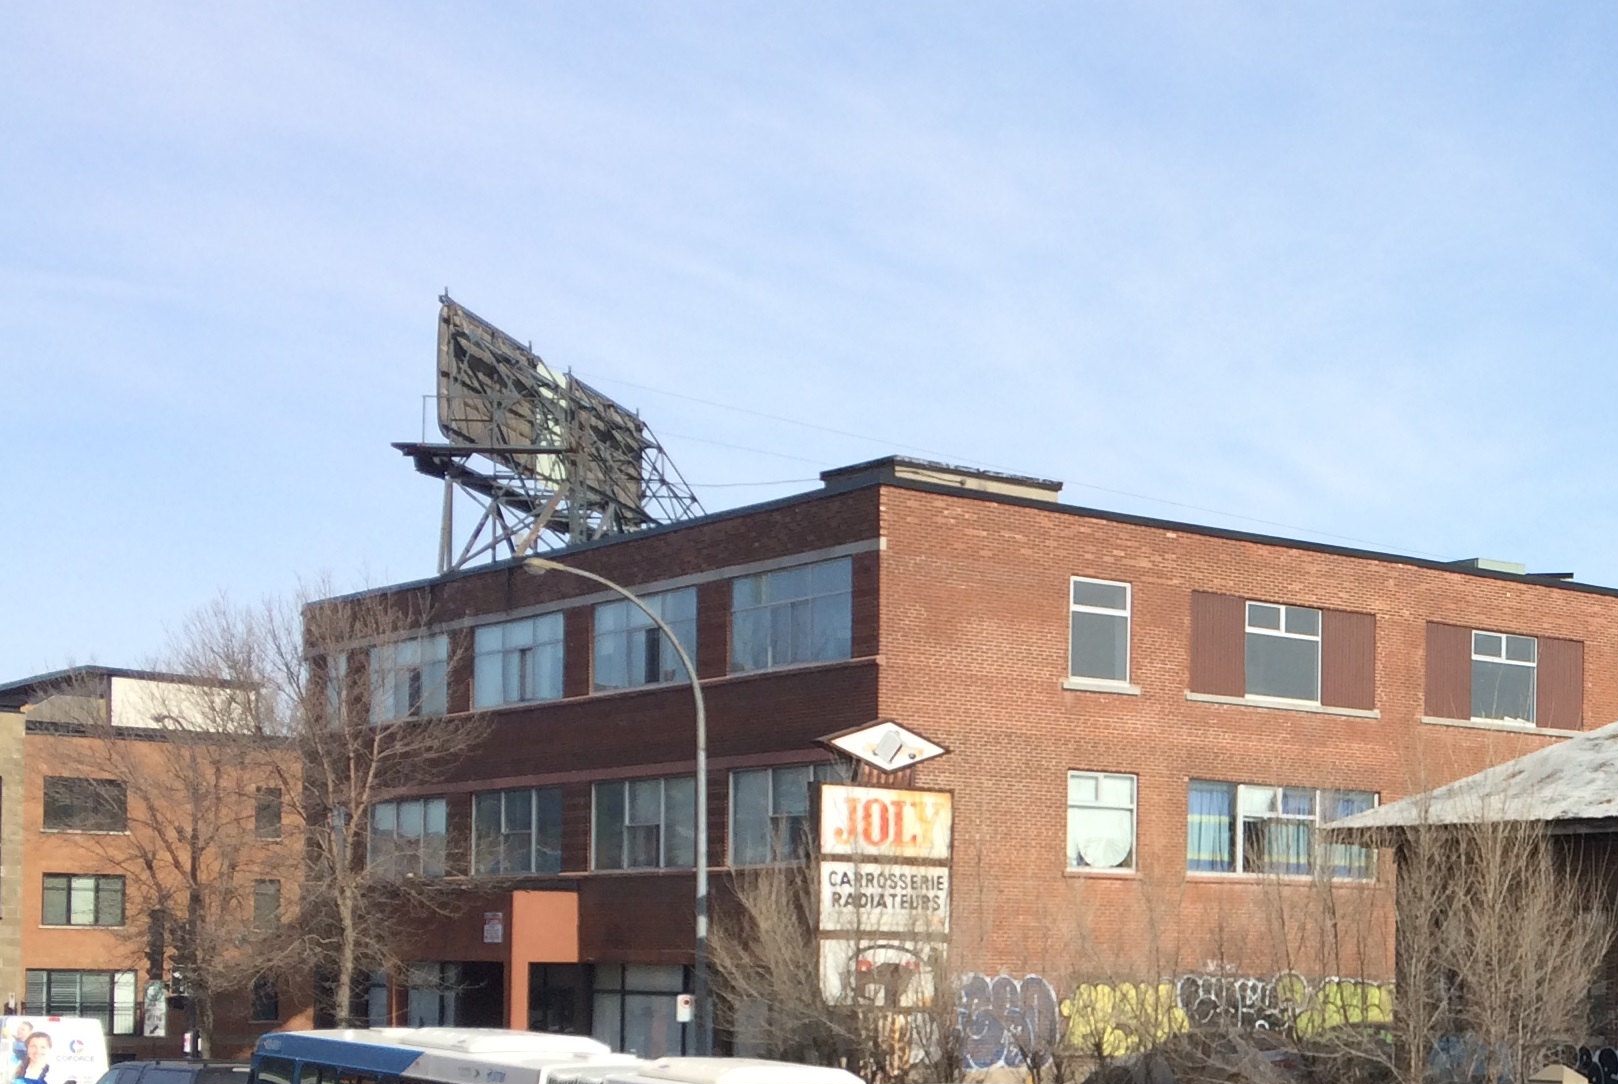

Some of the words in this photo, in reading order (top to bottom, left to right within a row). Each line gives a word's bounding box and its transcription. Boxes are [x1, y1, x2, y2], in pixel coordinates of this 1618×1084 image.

[833, 796, 947, 848] JOLY
[828, 870, 944, 892] CARROSSERIE
[832, 891, 941, 912] RADIATEURS
